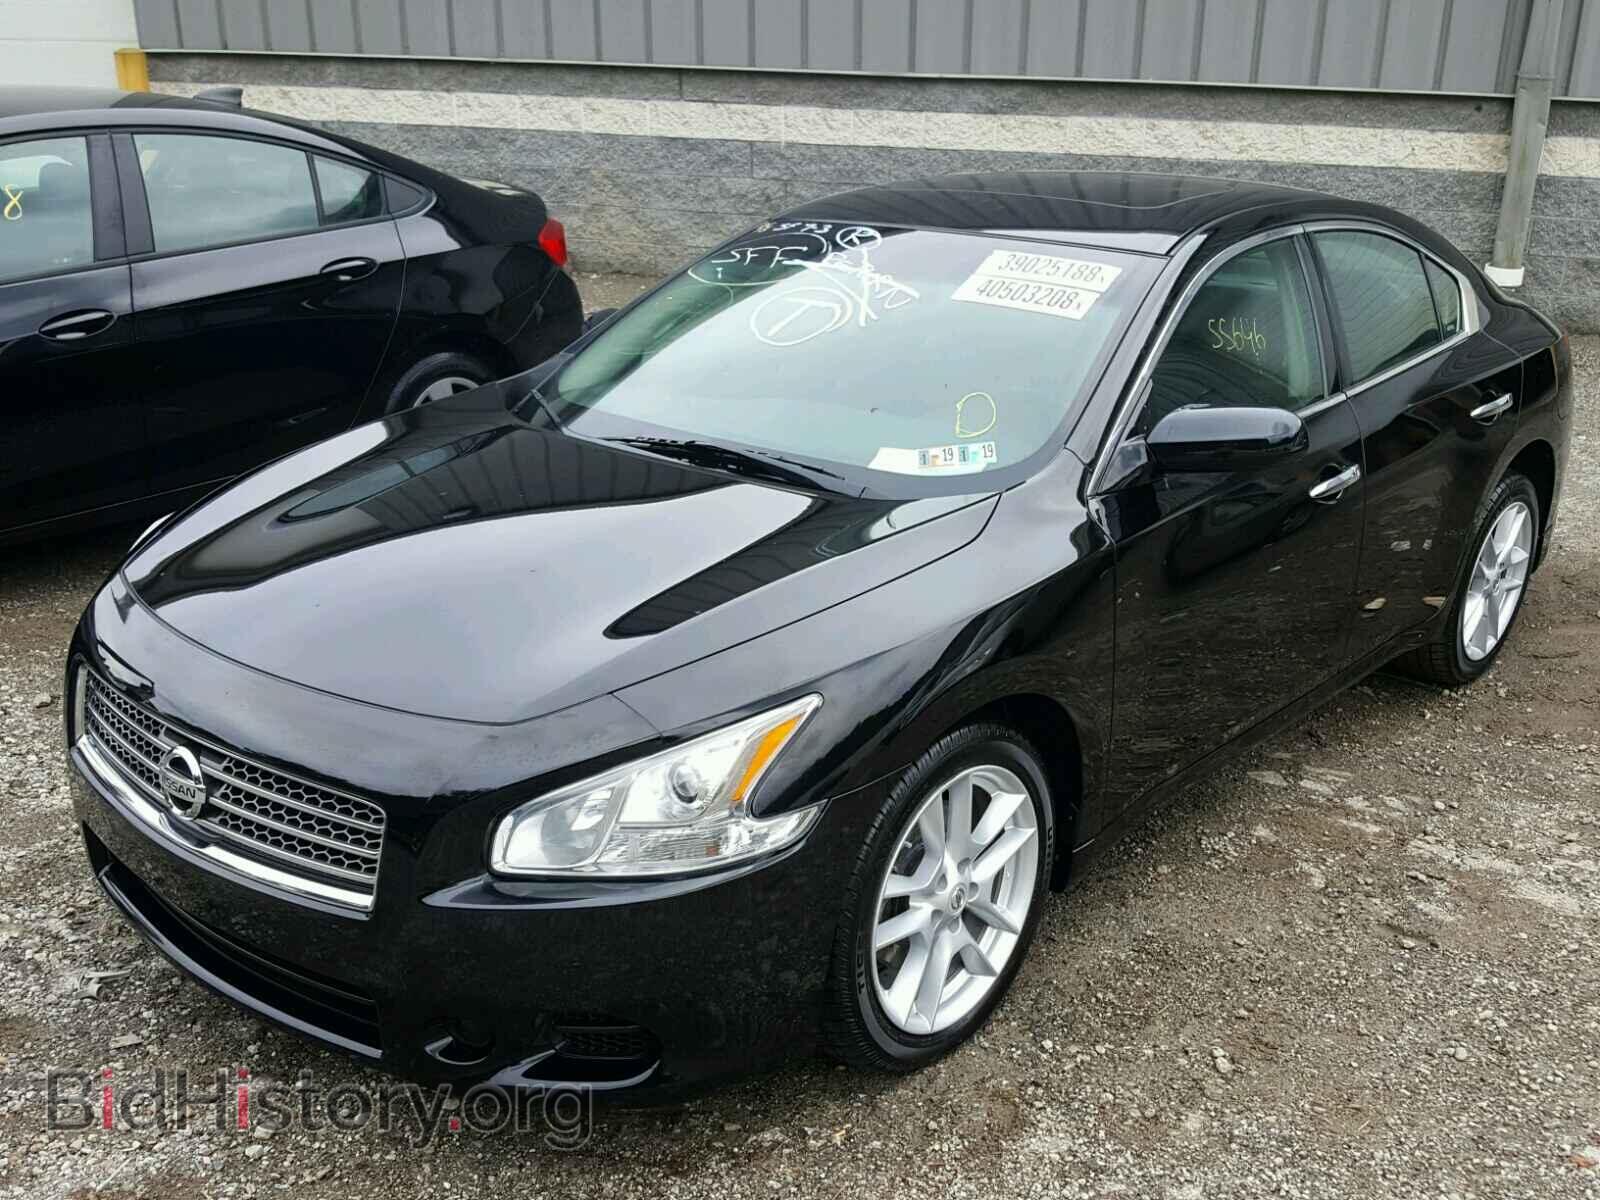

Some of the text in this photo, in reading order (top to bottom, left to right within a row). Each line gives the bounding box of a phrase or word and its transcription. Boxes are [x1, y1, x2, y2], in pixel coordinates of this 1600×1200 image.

[4, 184, 23, 220] 8
[998, 253, 1103, 283] 39025188
[976, 279, 1080, 310] 40503208
[942, 446, 954, 462] 19
[982, 443, 994, 459] 19
[165, 779, 196, 799] SSAN
